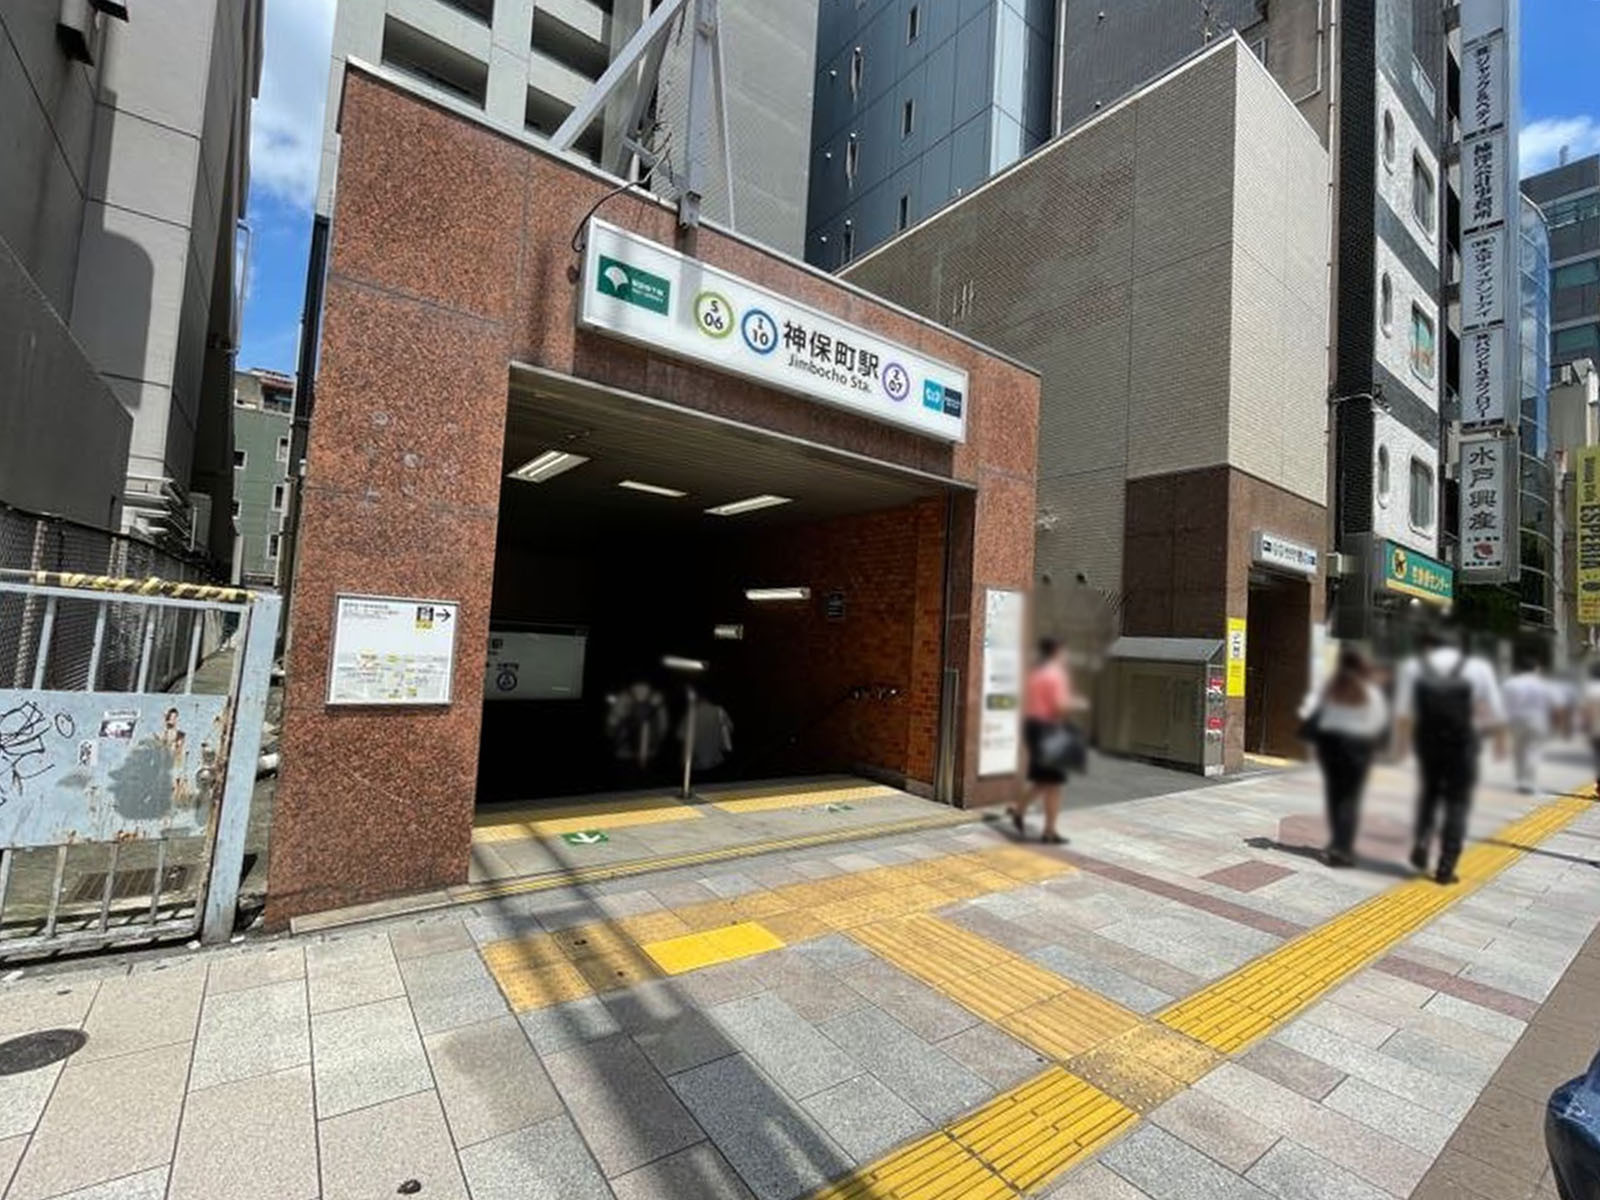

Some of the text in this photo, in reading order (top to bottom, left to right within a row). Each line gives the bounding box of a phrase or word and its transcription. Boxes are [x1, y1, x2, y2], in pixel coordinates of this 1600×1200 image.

[710, 300, 719, 313] S
[703, 312, 723, 331] 06
[752, 329, 769, 346] 10
[783, 320, 880, 380] 神保町駅
[788, 354, 872, 394] Jimbocho Sta.
[888, 379, 903, 394] 07
[1468, 446, 1497, 531] 水戸興産
